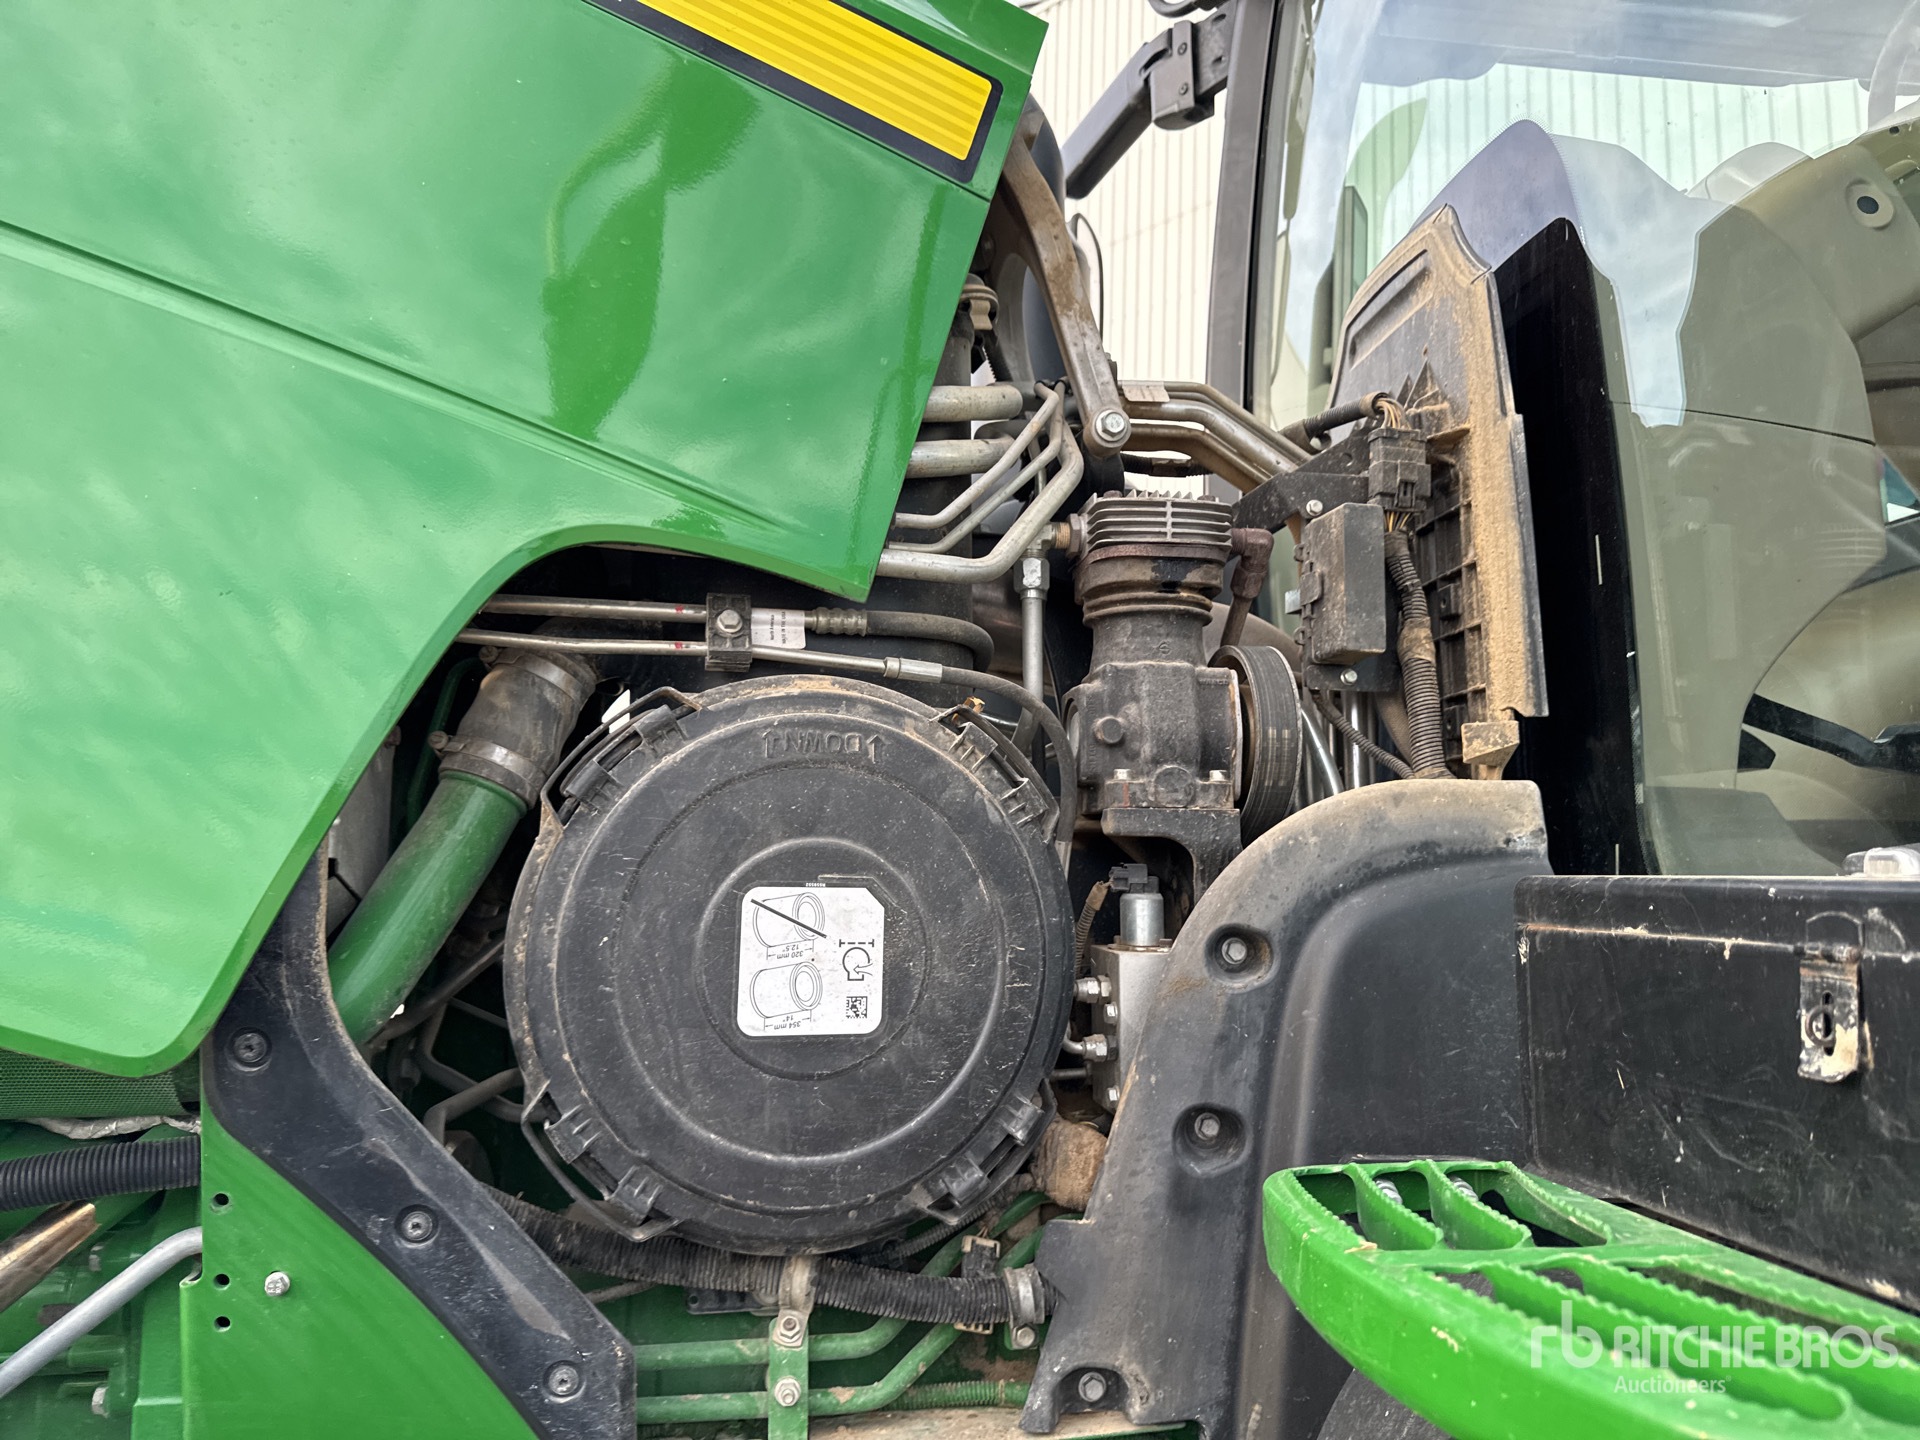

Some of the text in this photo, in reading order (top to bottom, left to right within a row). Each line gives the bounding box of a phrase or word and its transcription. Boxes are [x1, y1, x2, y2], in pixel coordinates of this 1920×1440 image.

[784, 728, 862, 753] DOWN
[776, 950, 804, 960] 320 mm
[774, 1020, 801, 1031] 354 mm
